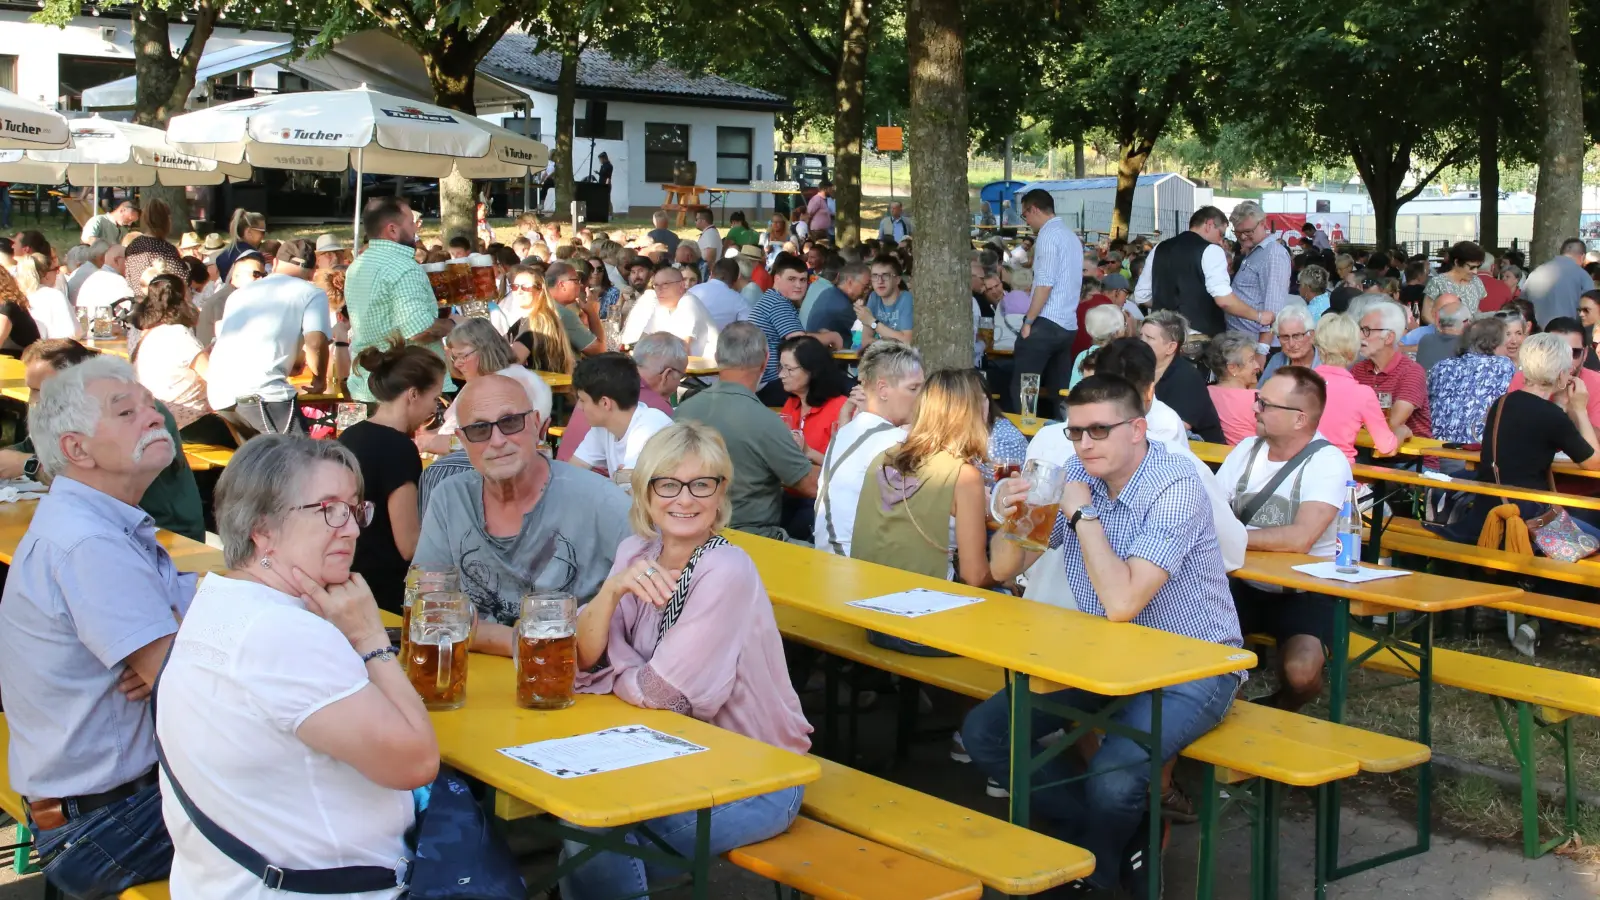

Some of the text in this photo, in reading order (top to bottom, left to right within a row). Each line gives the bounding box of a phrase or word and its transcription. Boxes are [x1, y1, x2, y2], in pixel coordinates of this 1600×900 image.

[391, 111, 450, 121] Tucher
[5, 119, 41, 134] Tucher
[294, 129, 342, 140] Tucher
[510, 147, 532, 160] Tucher
[162, 155, 195, 166] Tucher
